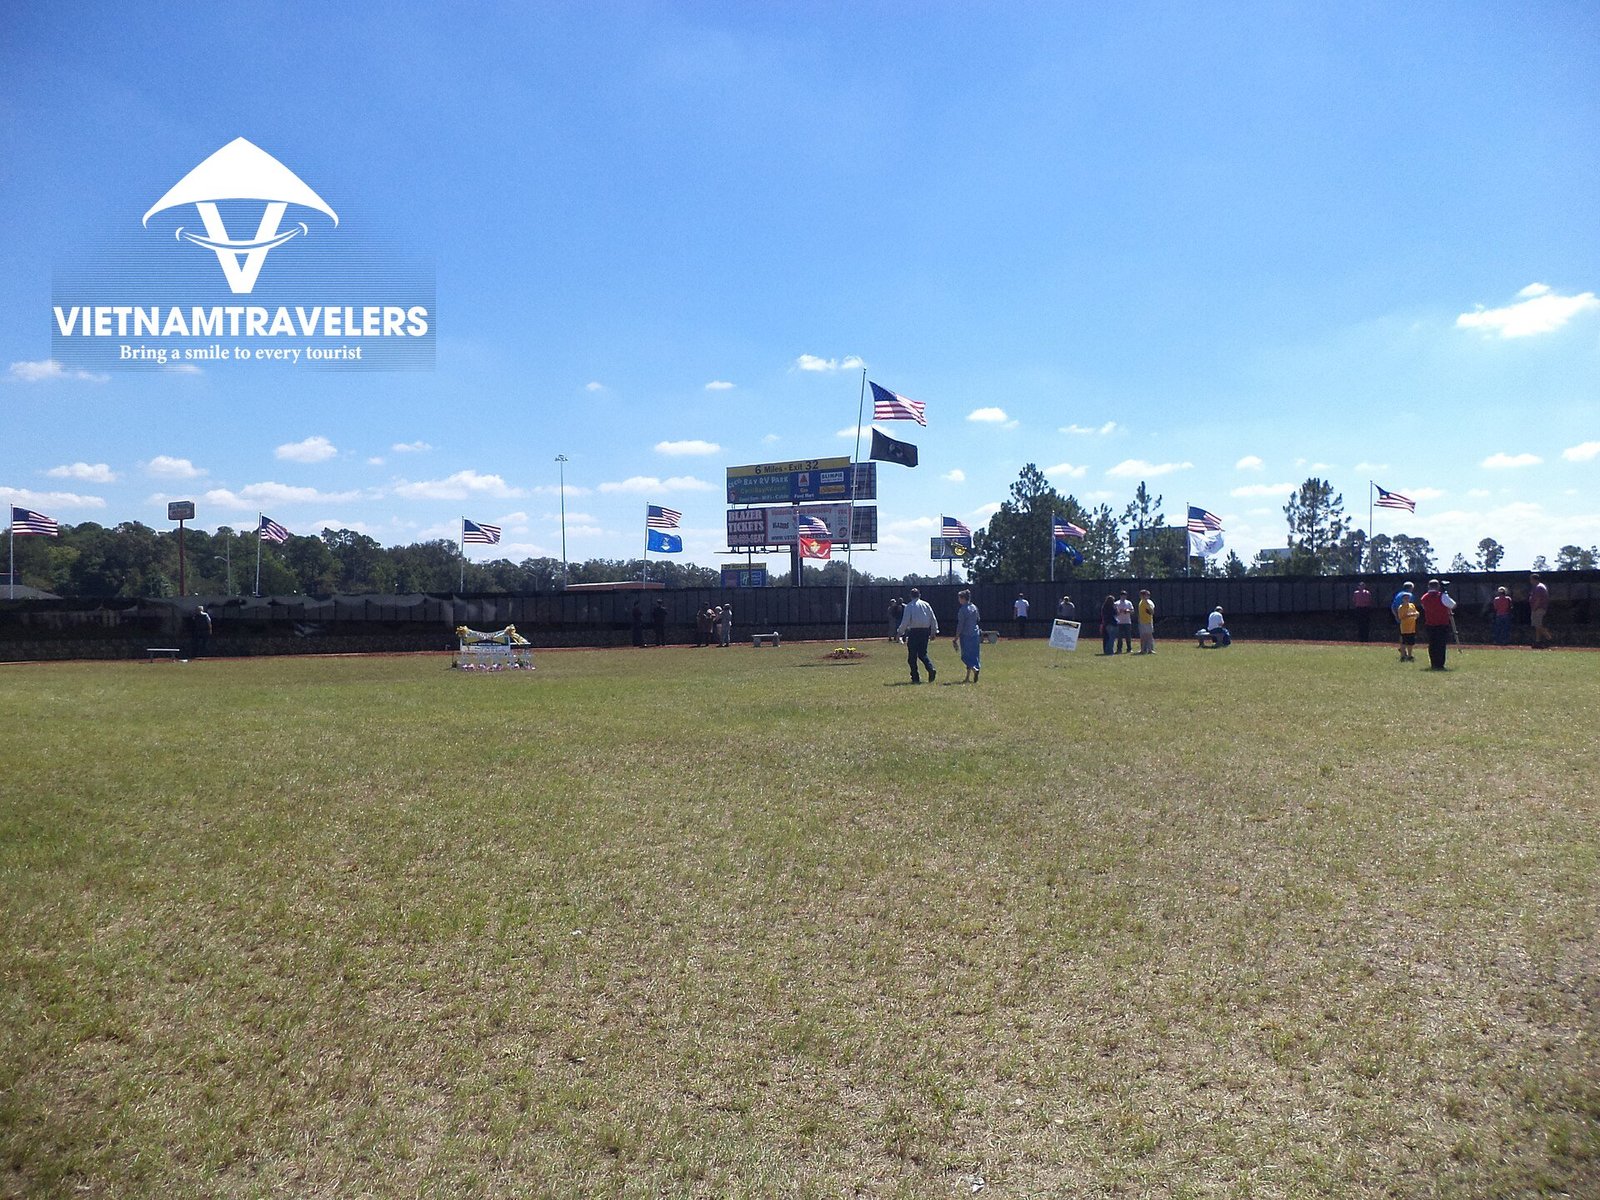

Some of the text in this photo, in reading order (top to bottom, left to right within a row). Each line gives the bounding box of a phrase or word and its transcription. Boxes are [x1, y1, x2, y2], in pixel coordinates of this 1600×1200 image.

[755, 464, 762, 474] 6
[764, 464, 782, 473] Miles
[789, 463, 803, 471] Exit
[805, 460, 819, 470] 32
[728, 510, 763, 521] BLAZER
[728, 521, 764, 533] TICKETS
